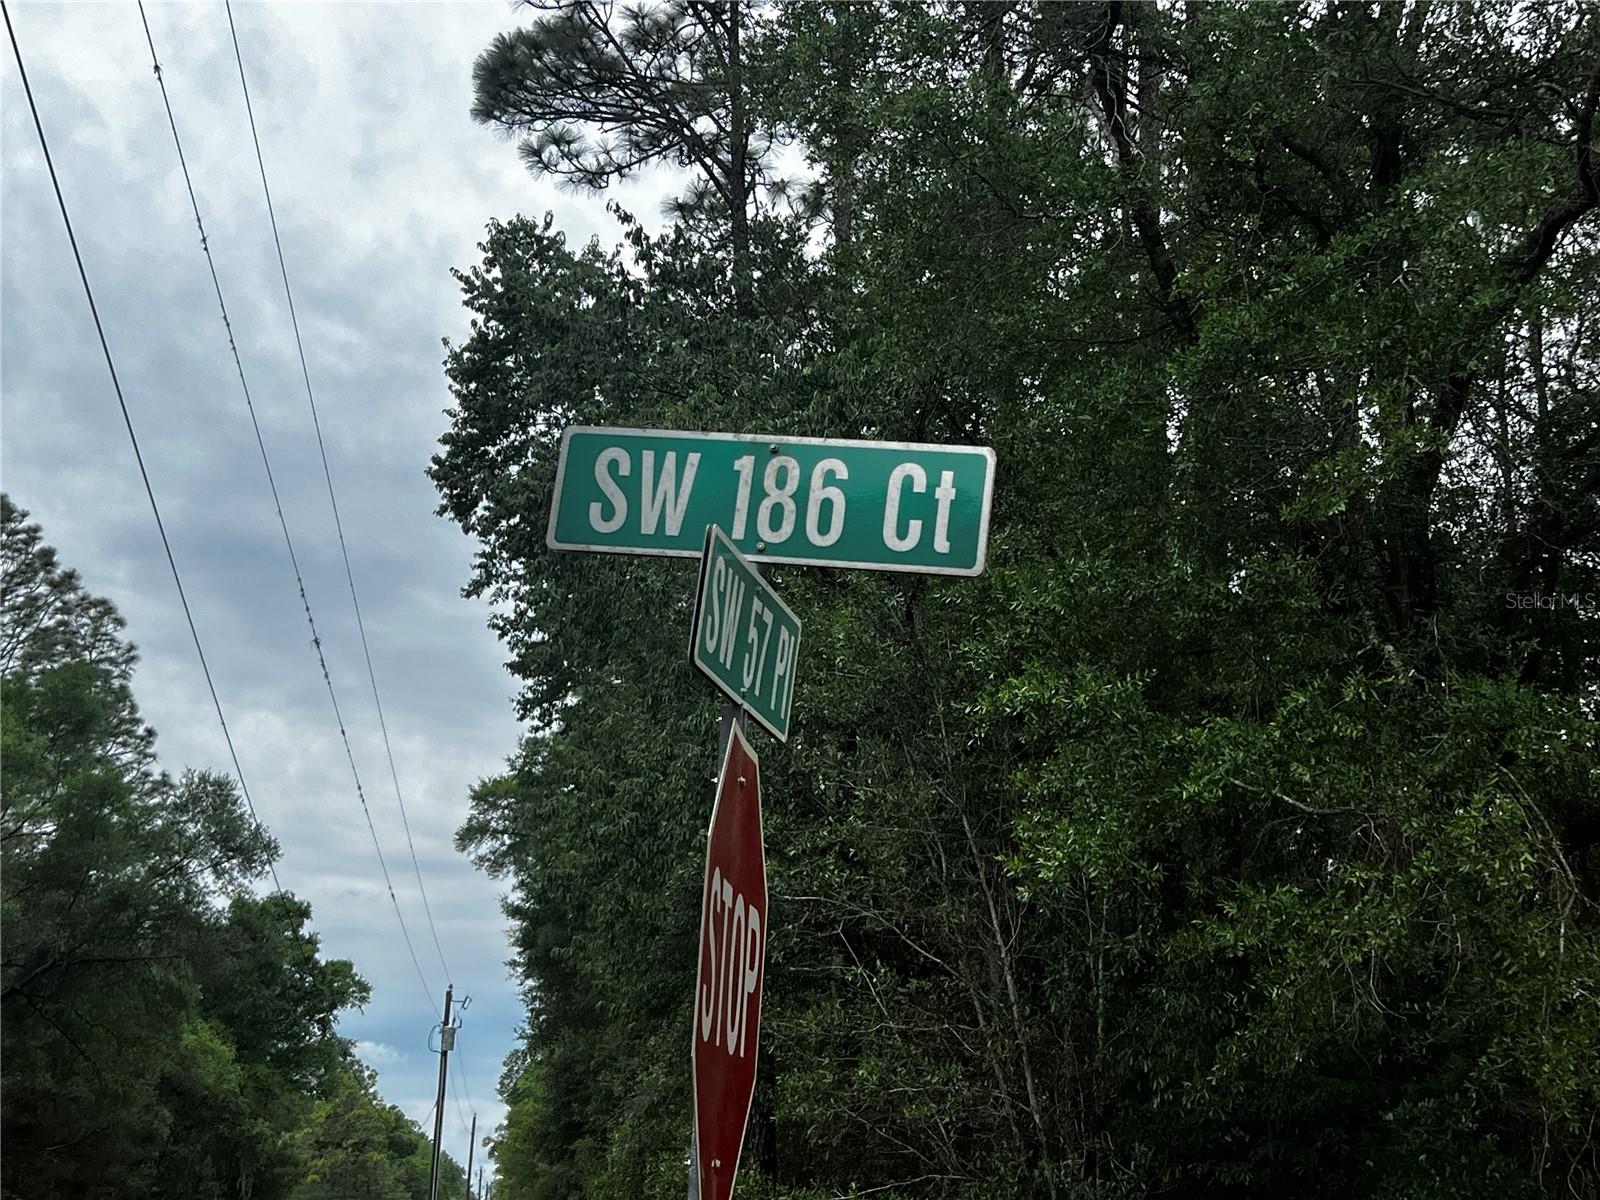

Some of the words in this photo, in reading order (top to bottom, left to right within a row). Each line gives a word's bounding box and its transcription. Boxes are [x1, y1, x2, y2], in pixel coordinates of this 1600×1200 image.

[589, 447, 701, 536] SW
[731, 455, 849, 547] 186
[883, 463, 956, 554] Ct
[706, 556, 745, 670] SW
[743, 596, 773, 697] 57
[770, 625, 795, 720] Pl
[702, 866, 760, 1058] STOP
